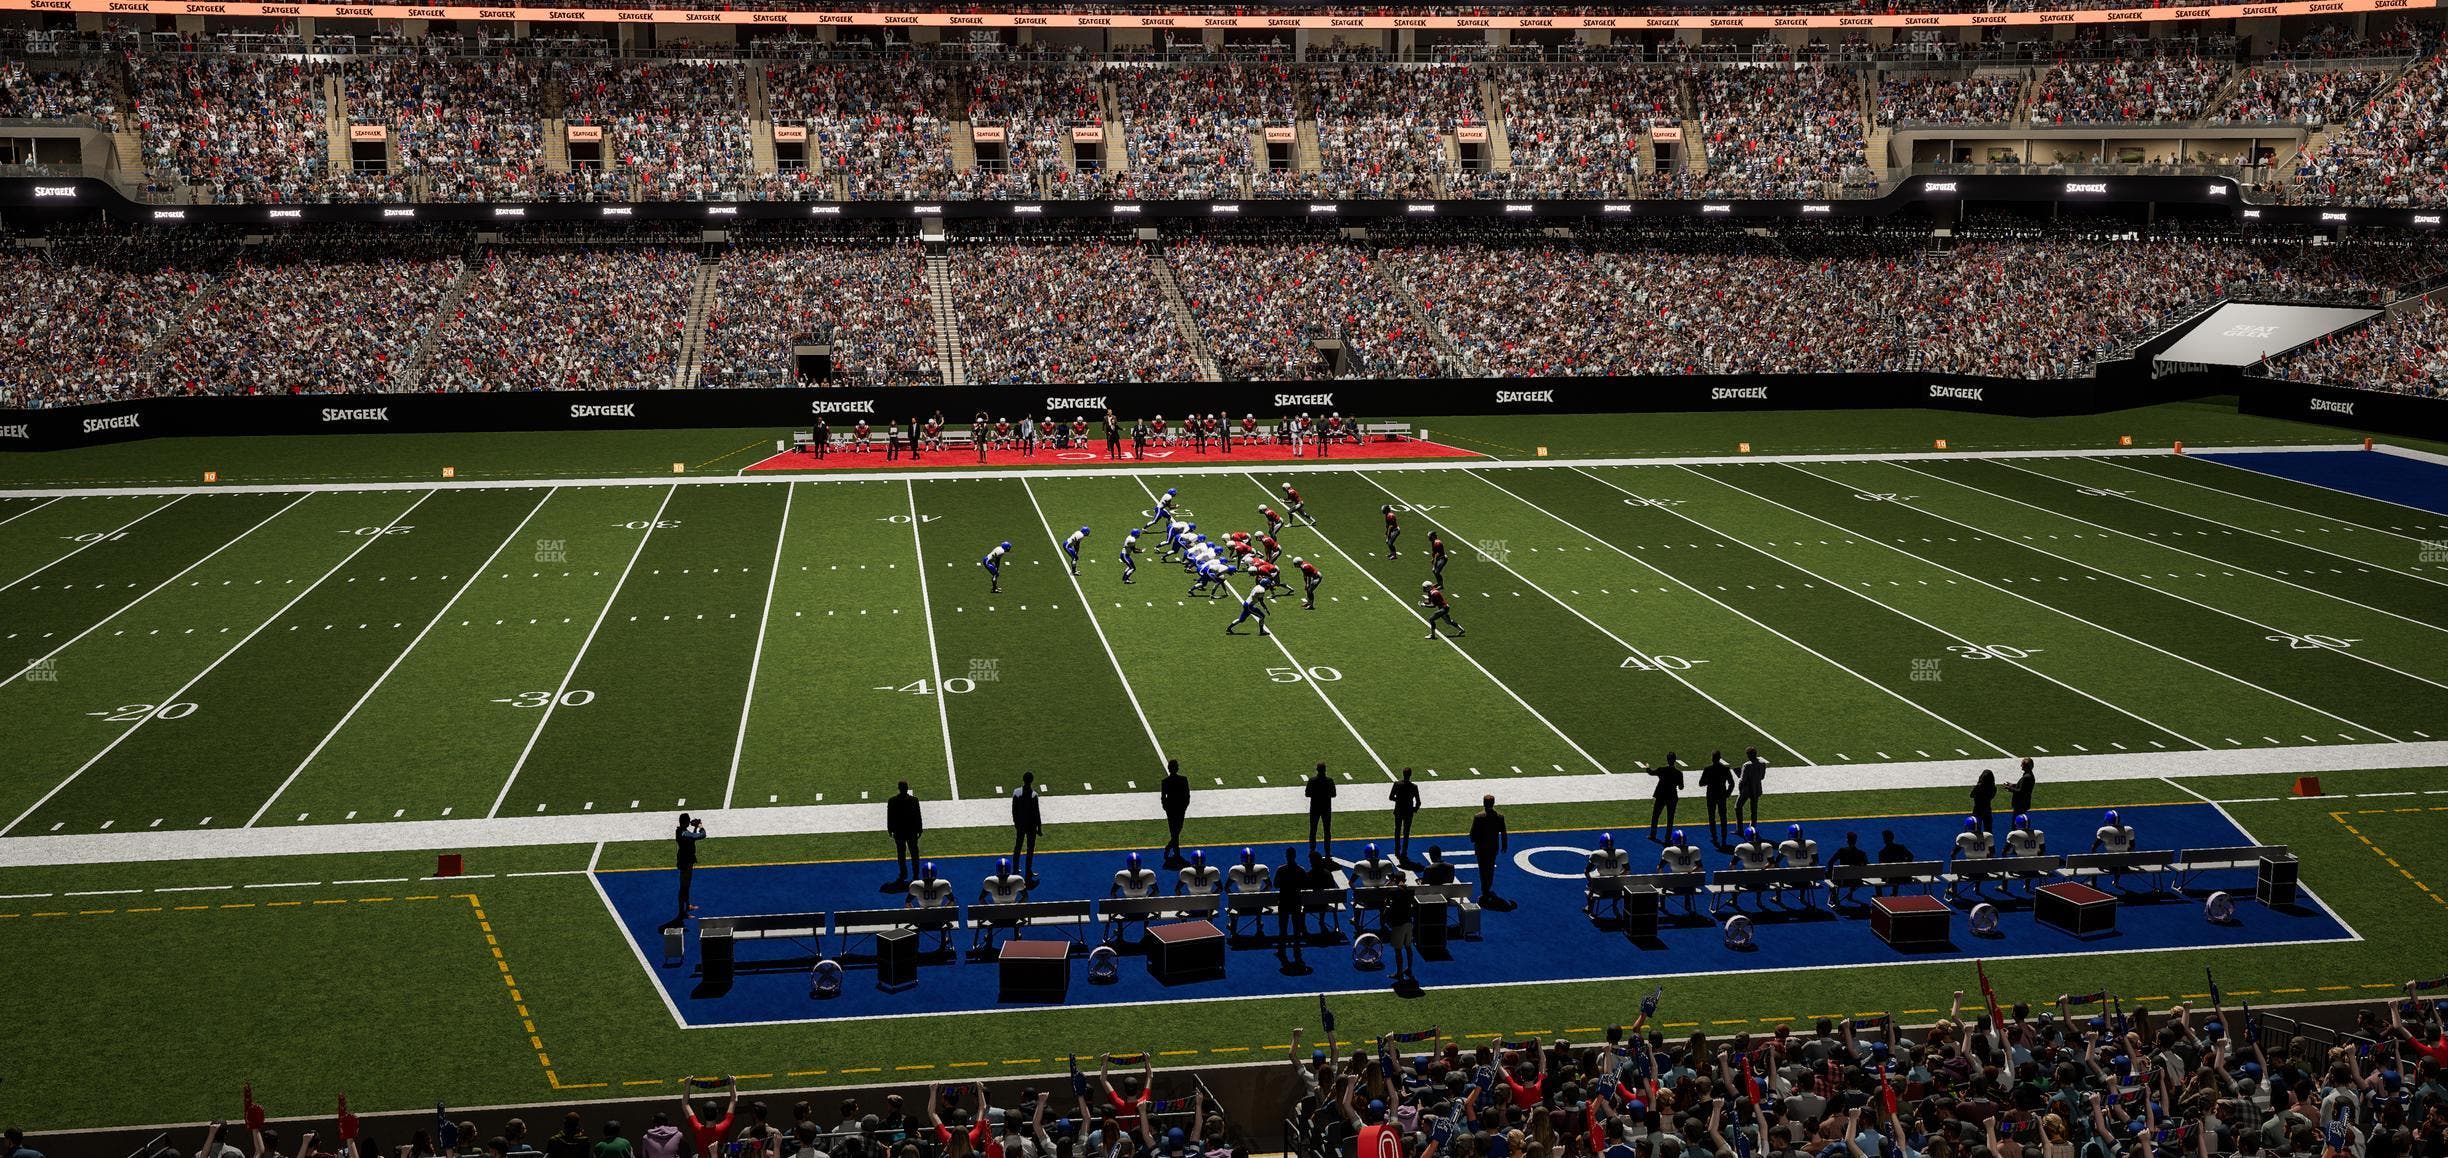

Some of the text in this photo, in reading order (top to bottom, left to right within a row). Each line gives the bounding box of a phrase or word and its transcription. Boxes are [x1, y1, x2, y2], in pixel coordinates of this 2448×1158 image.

[34, 187, 76, 197] SEATGEEK
[2066, 183, 2106, 193] SEATGEEK
[1275, 393, 1333, 406] SEATGEEK
[1496, 390, 1554, 403] SEATGEEK
[1712, 387, 1768, 400] SEATGEEK
[1930, 385, 1984, 401] SEATGEEK
[571, 403, 635, 417] SEATGEEK
[812, 400, 874, 414] SEATGEEK
[1047, 397, 1107, 410] SEATGEEK
[2311, 399, 2354, 416] SEATGEEK
[323, 407, 388, 421] SEATGEEK
[84, 413, 140, 432] SEATGEEK
[626, 520, 682, 530] 30
[889, 514, 943, 524] 40
[2265, 634, 2351, 650] 20
[1946, 644, 2028, 660] 30
[1620, 655, 1692, 671] 40
[1266, 666, 1343, 683] 50
[898, 678, 977, 695] 40
[512, 689, 595, 708] 30
[103, 702, 199, 722] 20
[1973, 842, 1985, 852] 00
[2024, 840, 2036, 850] 00
[2115, 836, 2127, 846] 00
[1678, 856, 1690, 866] 00
[1795, 850, 1807, 860] 00
[1605, 860, 1617, 870] 00
[1244, 874, 1257, 884] 00
[1369, 870, 1381, 880] 00
[1130, 880, 1142, 890] 00
[1195, 877, 1207, 887] 00
[924, 890, 936, 900] 00
[998, 886, 1010, 896] 00
